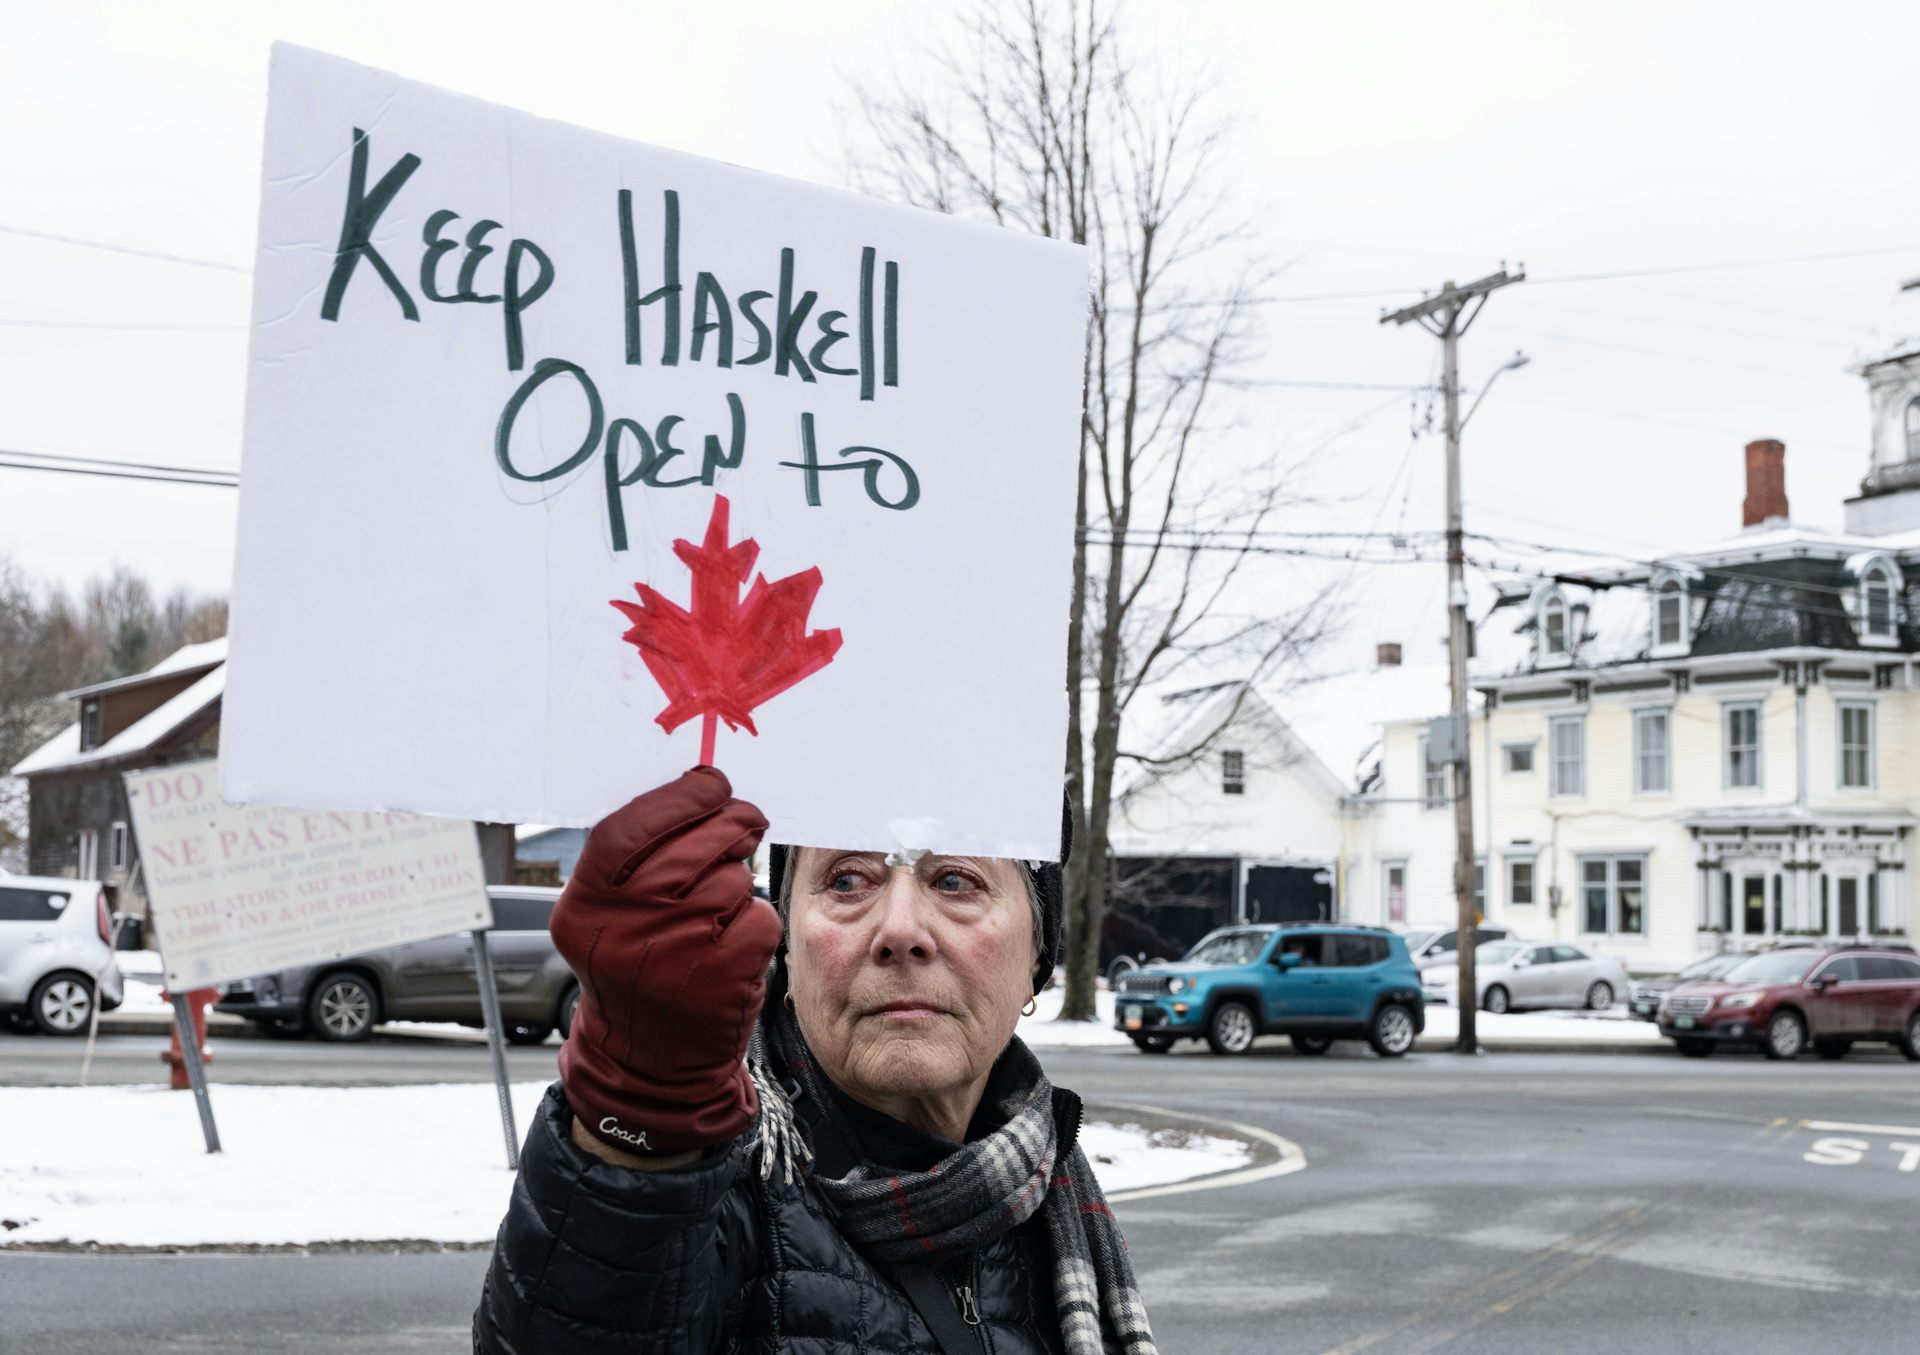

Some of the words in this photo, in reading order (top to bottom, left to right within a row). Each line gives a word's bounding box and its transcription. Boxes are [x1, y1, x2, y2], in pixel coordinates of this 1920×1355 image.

[145, 771, 204, 808] DO
[153, 836, 206, 871] NE
[219, 820, 288, 858] PAS
[599, 1117, 652, 1151] Coach
